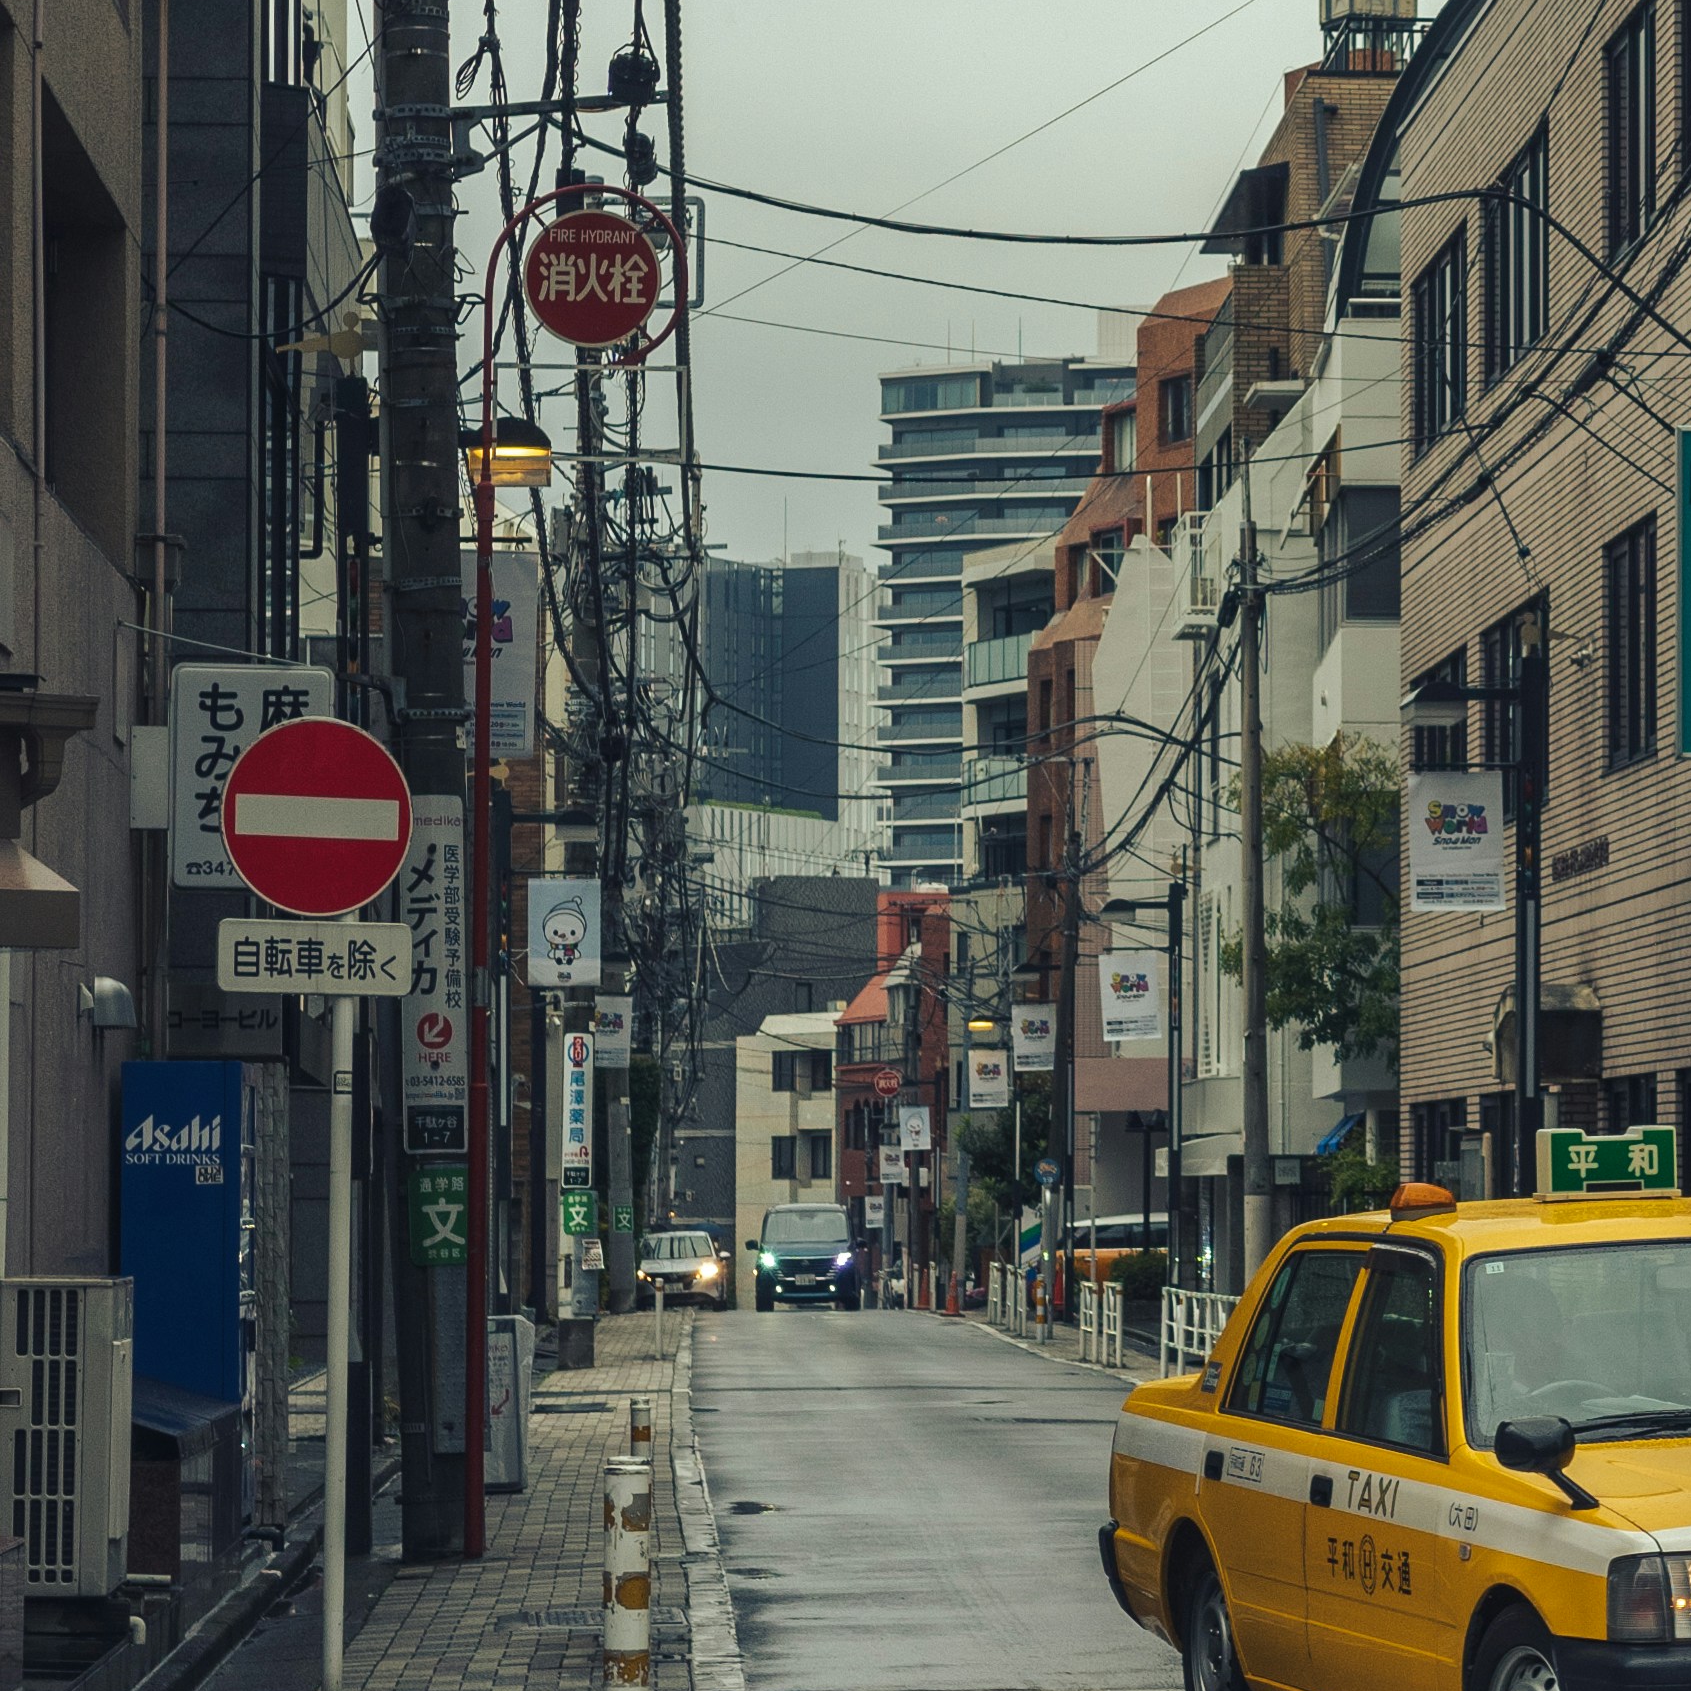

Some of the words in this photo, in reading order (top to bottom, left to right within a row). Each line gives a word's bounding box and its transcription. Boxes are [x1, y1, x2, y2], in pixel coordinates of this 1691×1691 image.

[550, 228, 576, 243] FIRE
[581, 229, 637, 245] HYDRANT
[538, 252, 649, 304] 消火栓
[1427, 800, 1486, 819] Snow
[1424, 816, 1488, 836] World
[1432, 836, 1460, 846] Snow
[406, 852, 441, 996] メディカ
[443, 844, 462, 1009] 医学部受験予備校
[233, 936, 397, 981] 自転車を除く
[418, 1052, 452, 1063] HERE
[410, 1075, 465, 1087] 03-5412-6585
[125, 1114, 221, 1151] Asahi
[415, 1116, 457, 1128] 千駄ヶ谷
[424, 1131, 450, 1143] 1-7
[125, 1153, 162, 1164] SOFT
[166, 1153, 220, 1165] DRINKS
[1567, 1143, 1659, 1178] 平和
[420, 1176, 464, 1192] 通学路
[421, 1197, 466, 1247] 文
[568, 1204, 588, 1226] 文
[1348, 1470, 1400, 1519] TAXI
[1327, 1537, 1355, 1580] 平和
[1381, 1548, 1412, 1595] 交通
